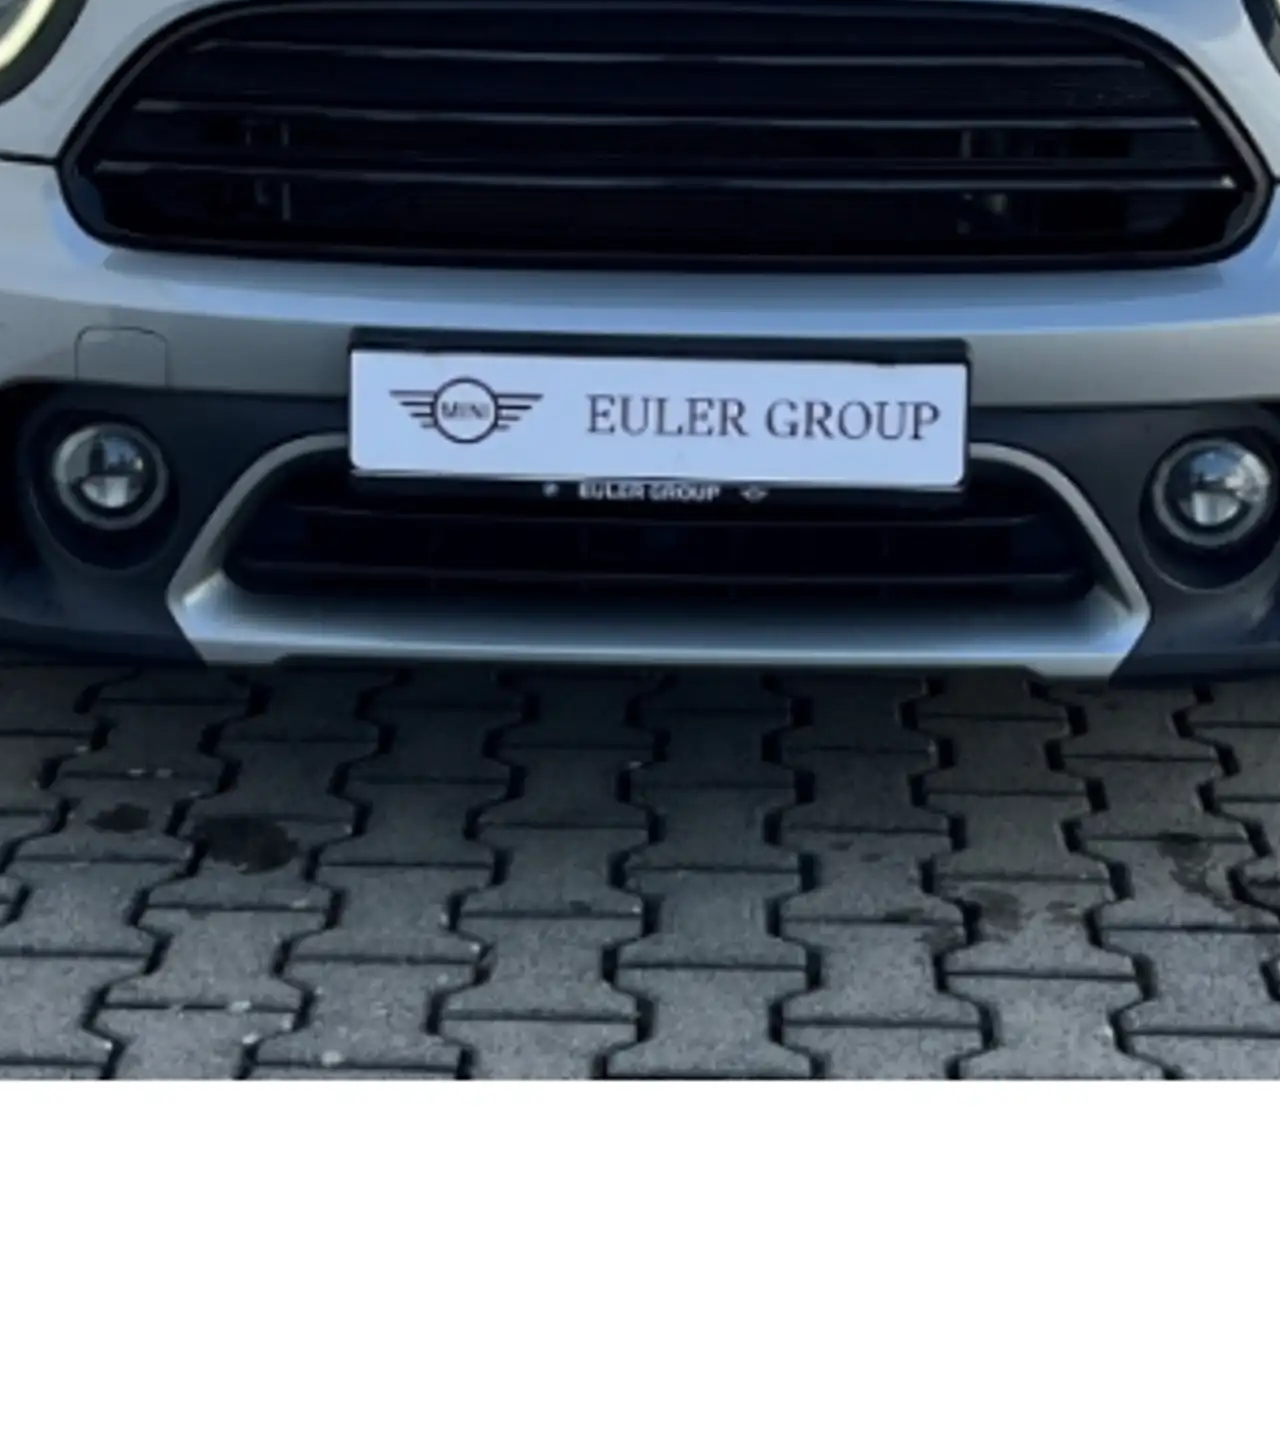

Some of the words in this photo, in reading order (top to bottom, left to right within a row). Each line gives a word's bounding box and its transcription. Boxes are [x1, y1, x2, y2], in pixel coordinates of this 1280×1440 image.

[441, 401, 490, 419] MINI
[586, 394, 748, 436] EULER
[765, 401, 941, 441] GROUP
[578, 480, 644, 500] EULER
[649, 481, 720, 502] GROUP
